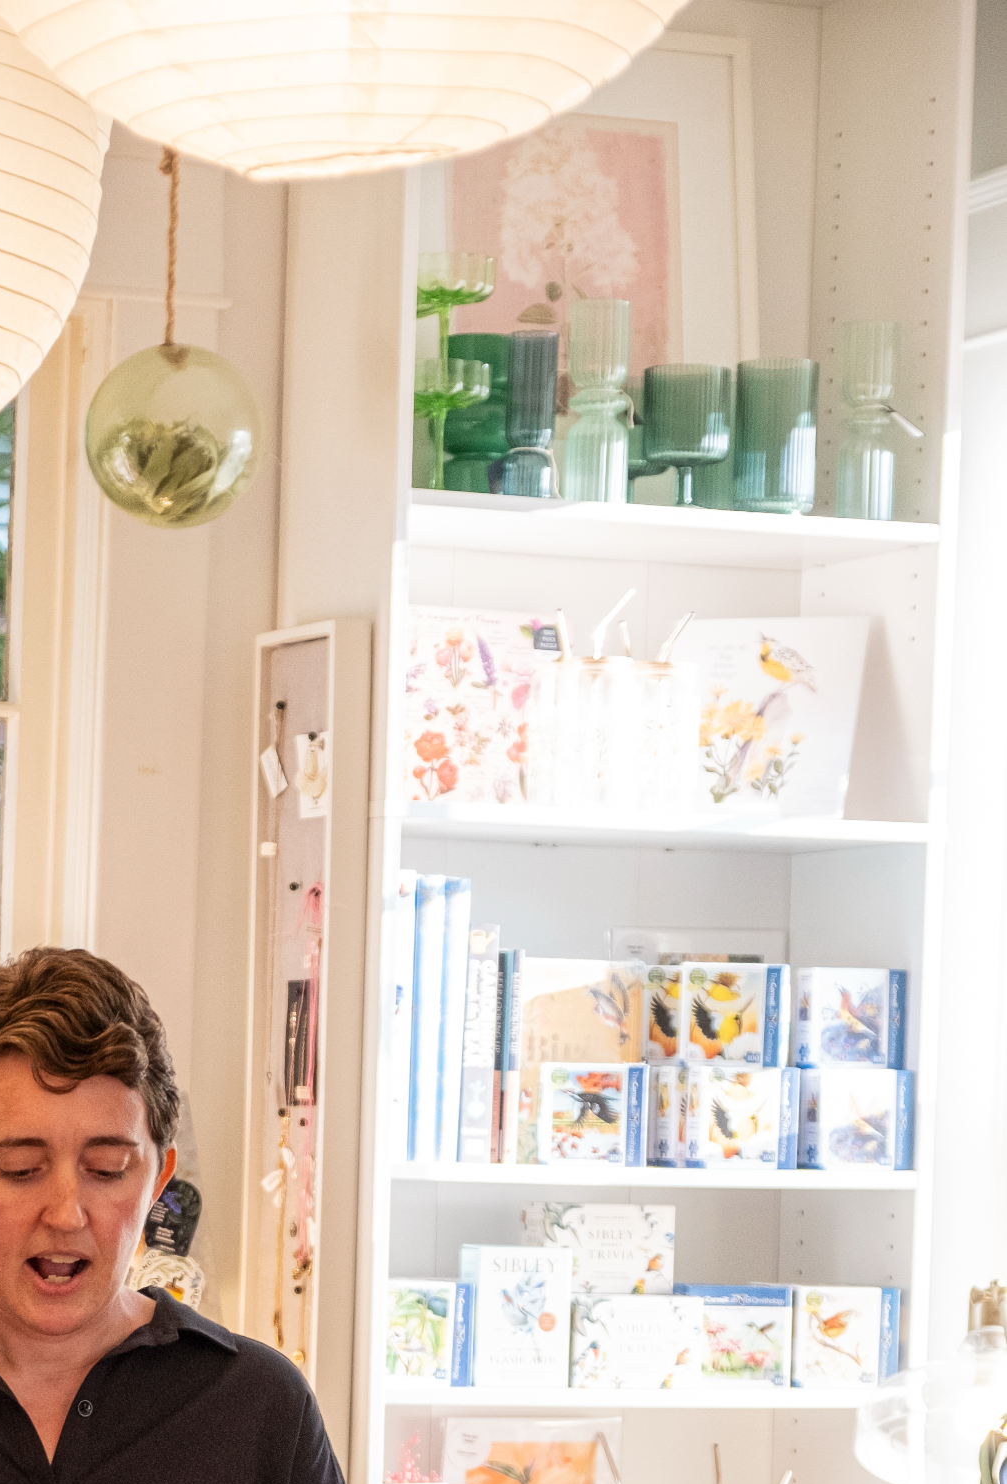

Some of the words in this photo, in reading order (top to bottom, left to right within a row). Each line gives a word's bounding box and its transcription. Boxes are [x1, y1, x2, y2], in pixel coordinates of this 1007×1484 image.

[479, 959, 497, 1068] GARDENING
[588, 1229, 634, 1240] SIBLEY
[588, 1249, 634, 1259] TRIVIA
[492, 1256, 559, 1273] SIBLEY
[617, 1323, 663, 1334] SIBLEY
[618, 1343, 663, 1354] TRIVIA
[490, 1356, 558, 1365] FLASHCARDS
